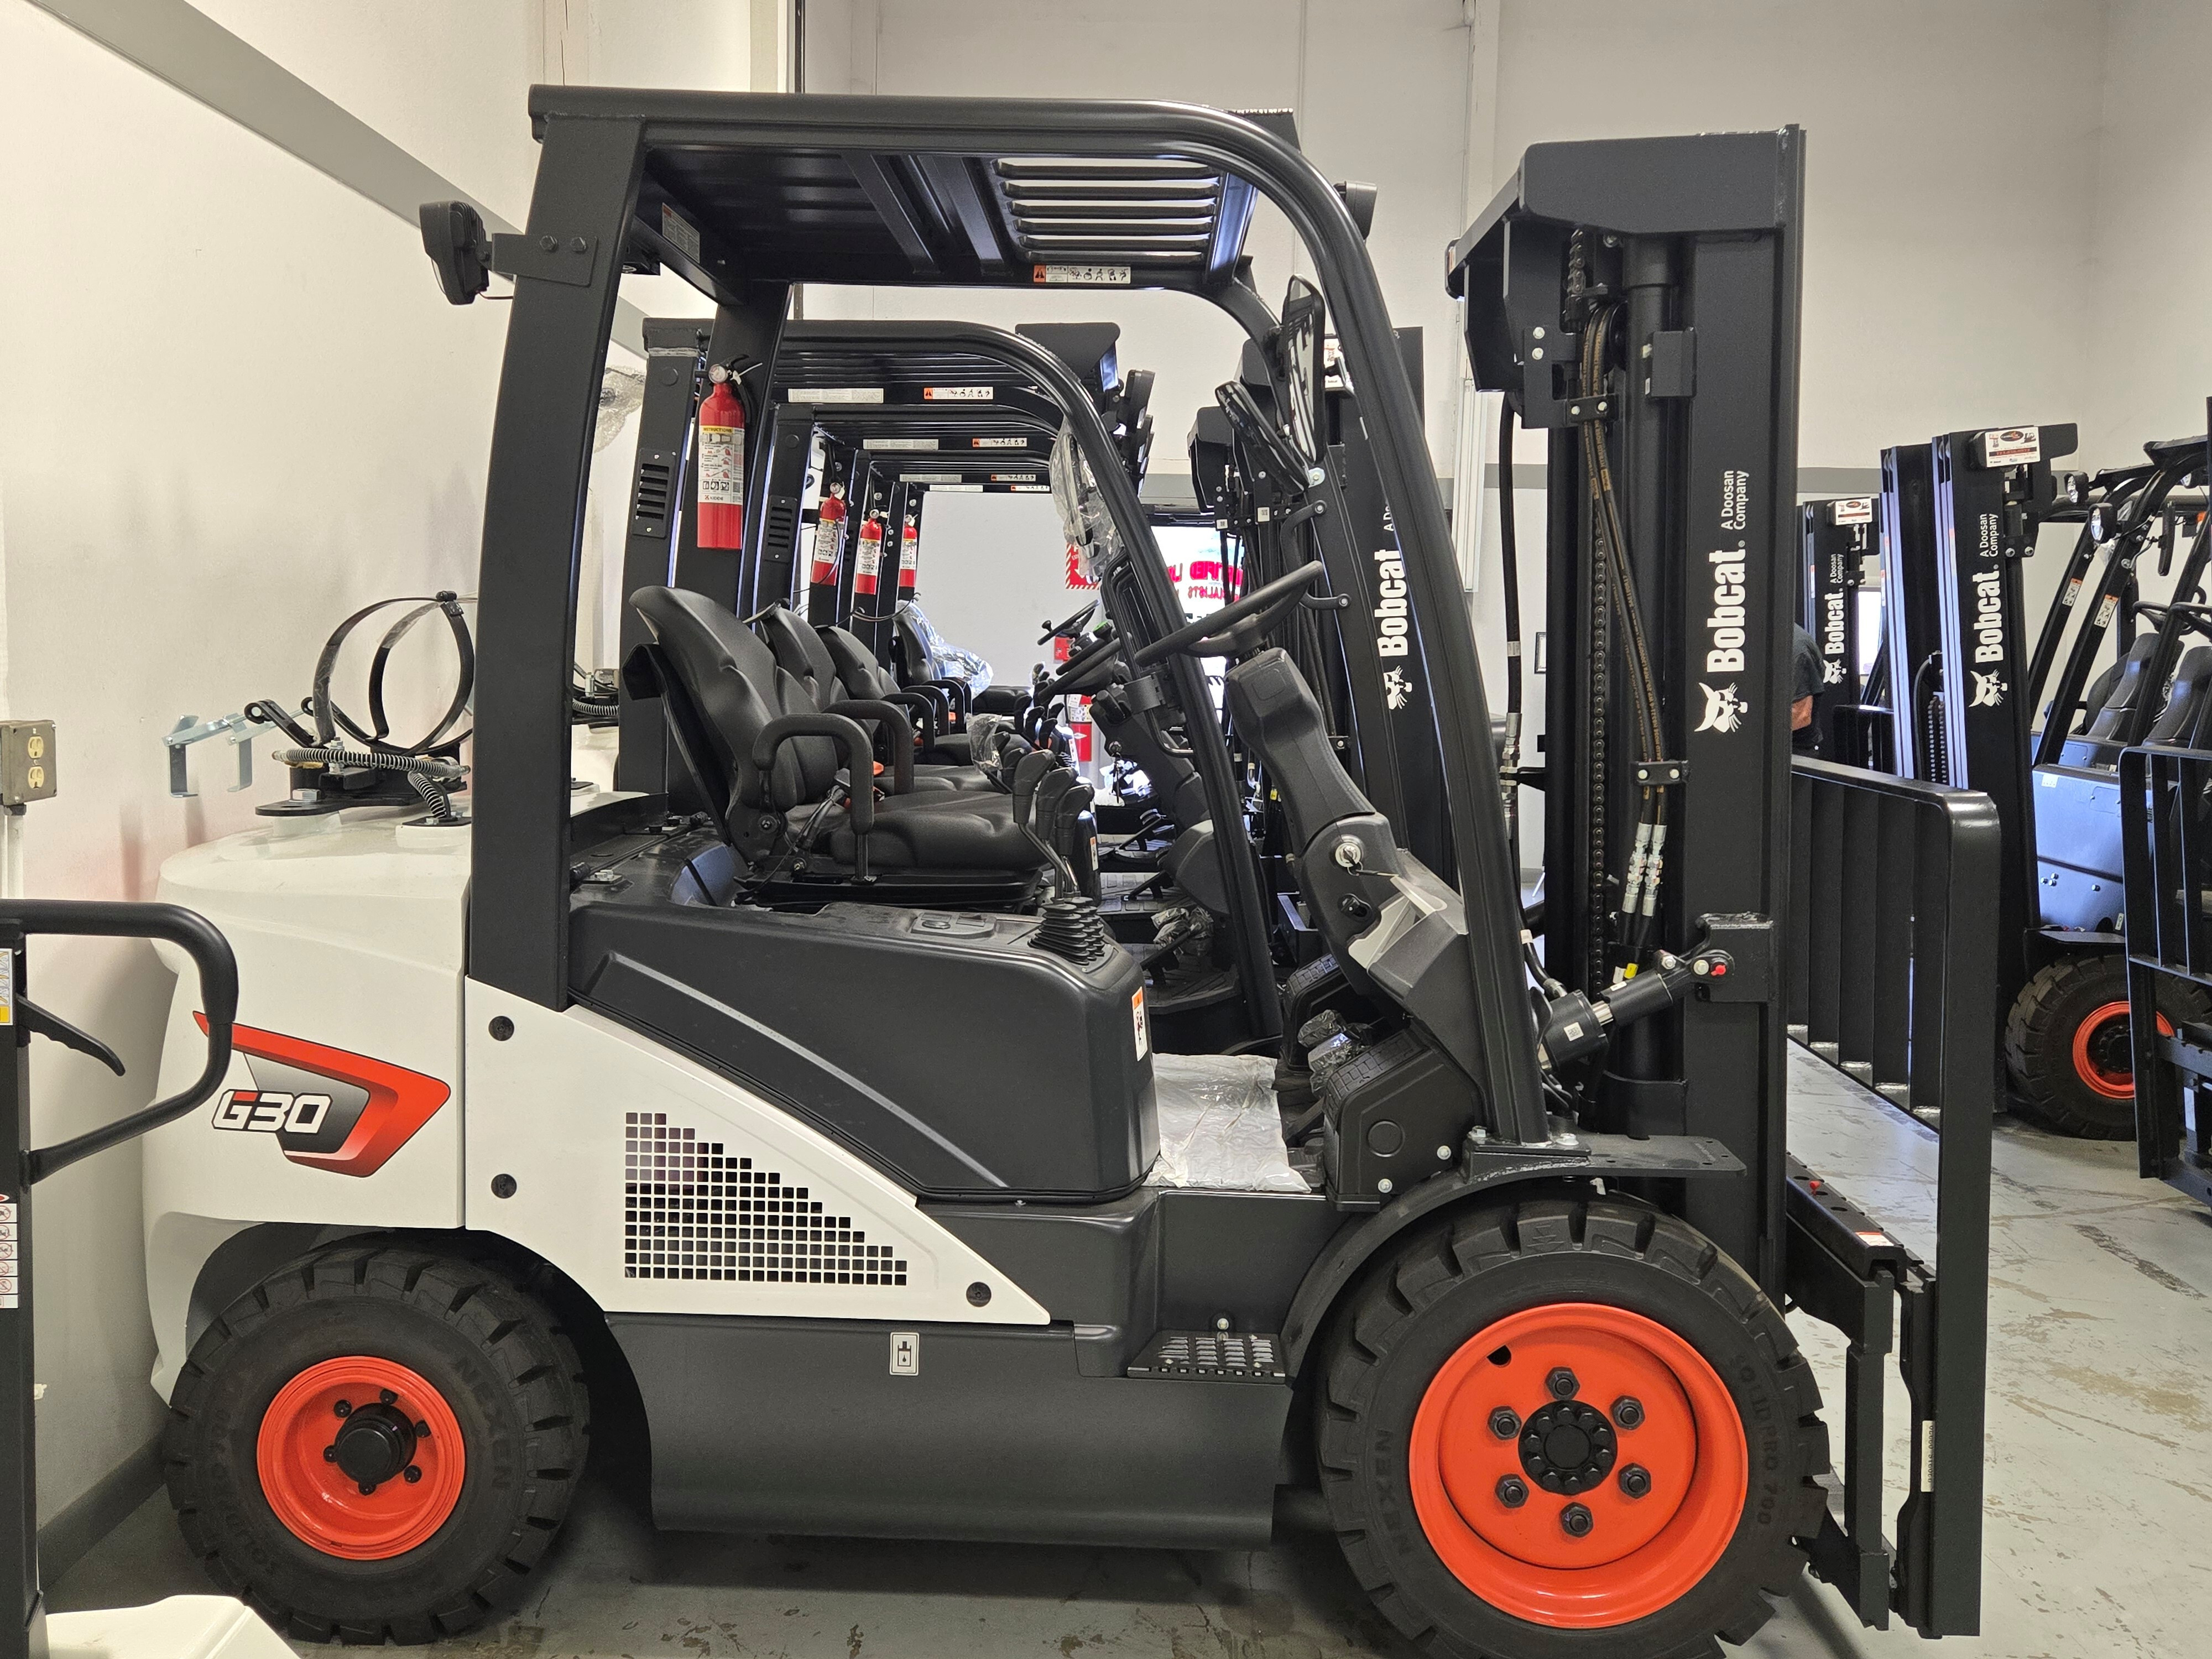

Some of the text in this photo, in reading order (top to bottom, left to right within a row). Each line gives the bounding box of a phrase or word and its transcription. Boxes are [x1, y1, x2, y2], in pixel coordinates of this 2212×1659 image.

[1721, 470, 1734, 530] A Doosan
[1733, 470, 1750, 530] Company
[1980, 513, 1990, 557] A Doosan
[1989, 513, 2000, 557] Company
[1837, 554, 1845, 584] Company
[1374, 549, 1408, 658] Bobcat
[1707, 549, 1746, 672] Bobcat
[1824, 592, 1845, 655] Bobcat
[1972, 570, 2004, 664] Bobcat
[212, 1089, 333, 1135] G30
